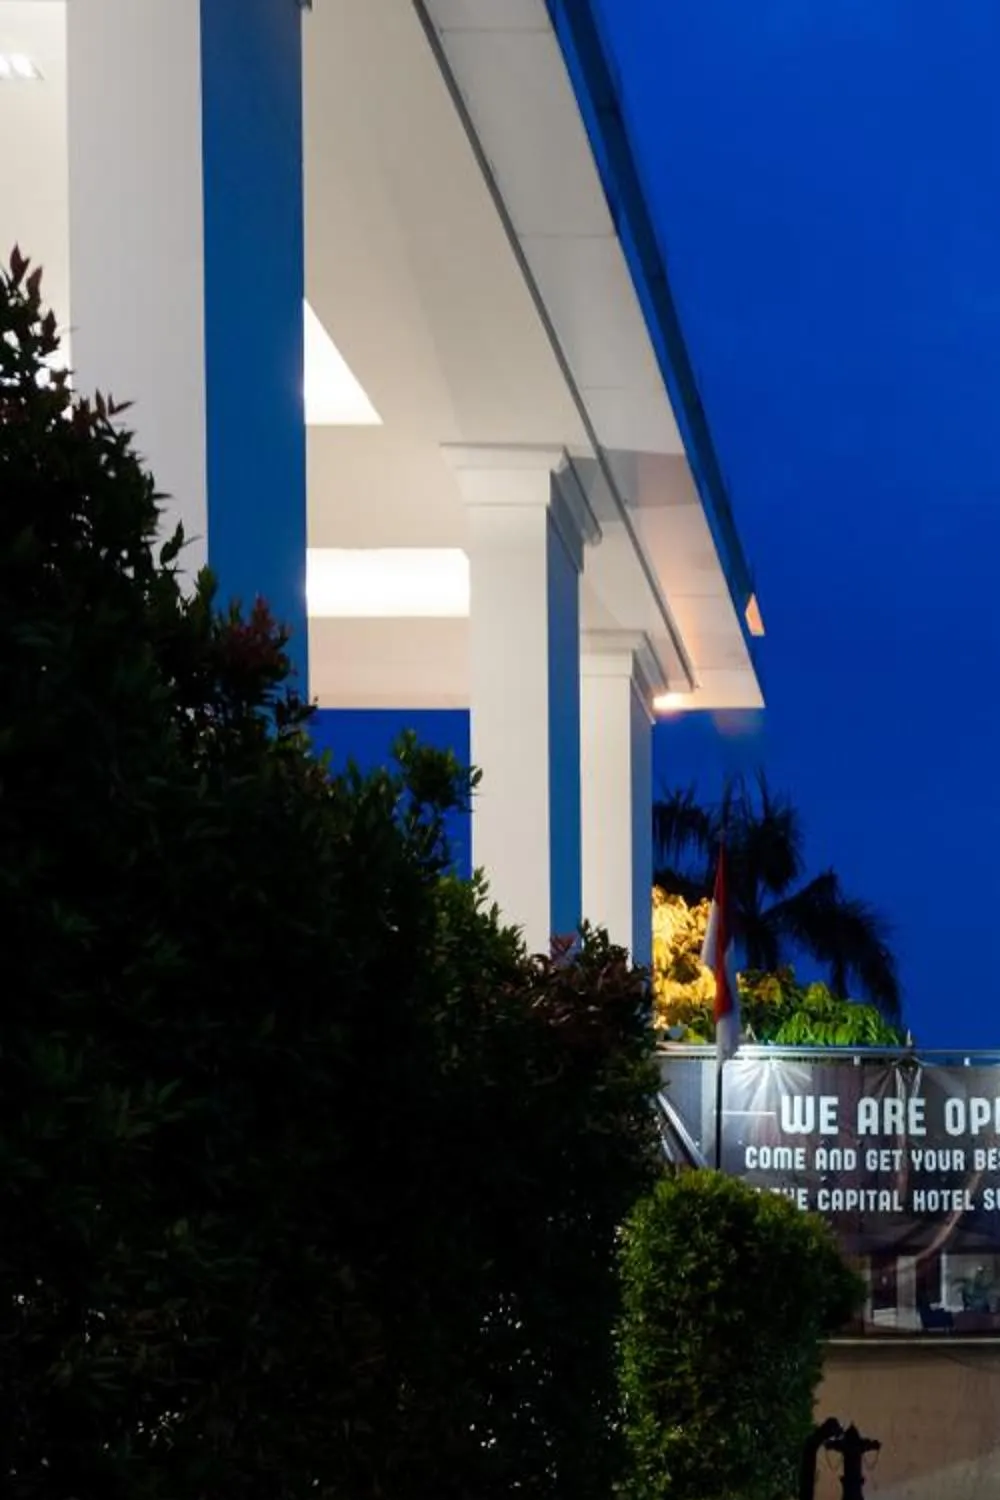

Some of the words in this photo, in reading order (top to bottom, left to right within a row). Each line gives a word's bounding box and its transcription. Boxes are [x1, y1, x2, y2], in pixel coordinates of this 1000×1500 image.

[781, 1096, 838, 1135] WE
[857, 1096, 925, 1136] ARE
[745, 1147, 805, 1170] COME
[815, 1148, 856, 1171] AND
[866, 1148, 902, 1171] GET
[911, 1149, 965, 1171] YOUR
[817, 1189, 903, 1211] CAPITAL
[912, 1189, 975, 1211] HOTEL
